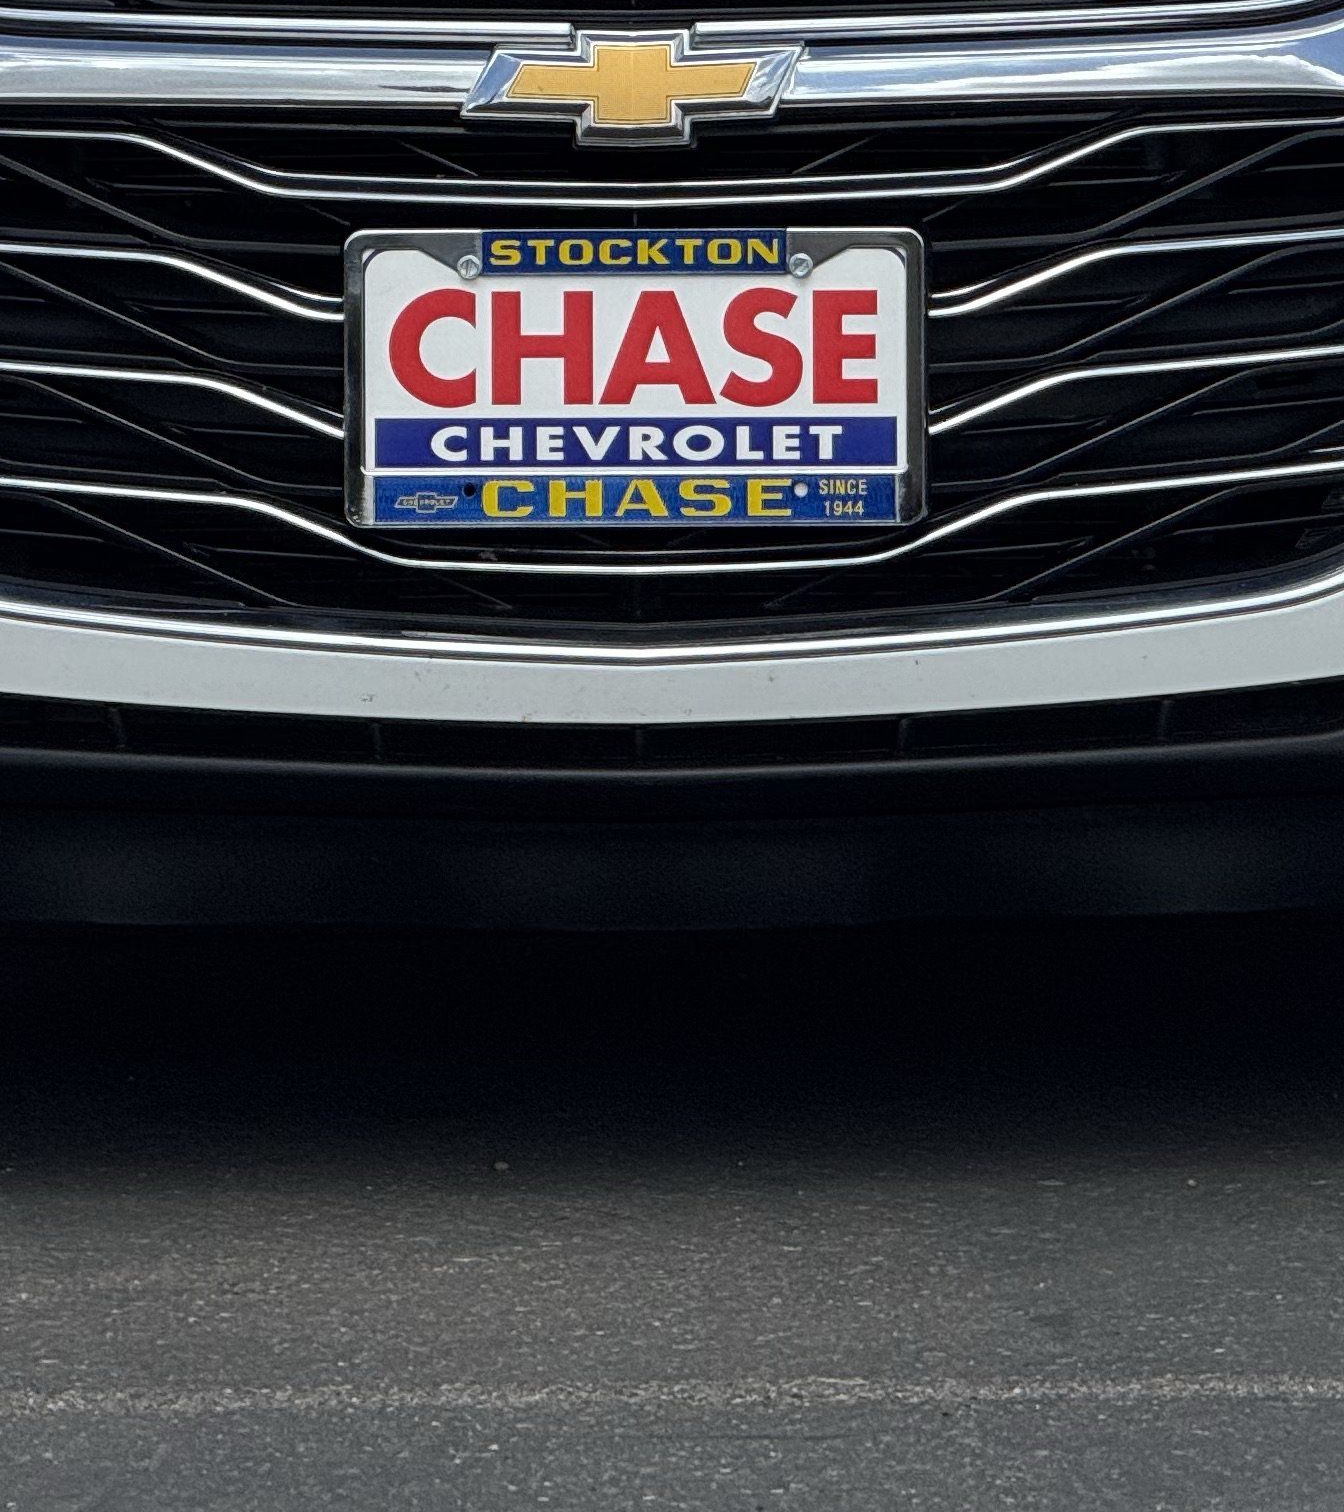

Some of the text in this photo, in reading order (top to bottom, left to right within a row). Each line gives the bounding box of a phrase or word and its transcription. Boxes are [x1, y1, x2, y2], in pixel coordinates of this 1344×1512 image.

[490, 238, 778, 266] STOCKTON
[388, 288, 879, 408] CHASE
[430, 424, 843, 462] CHEVROLET
[481, 479, 793, 518] CHASE
[818, 479, 868, 497] SINCE
[824, 500, 864, 517] 1944
